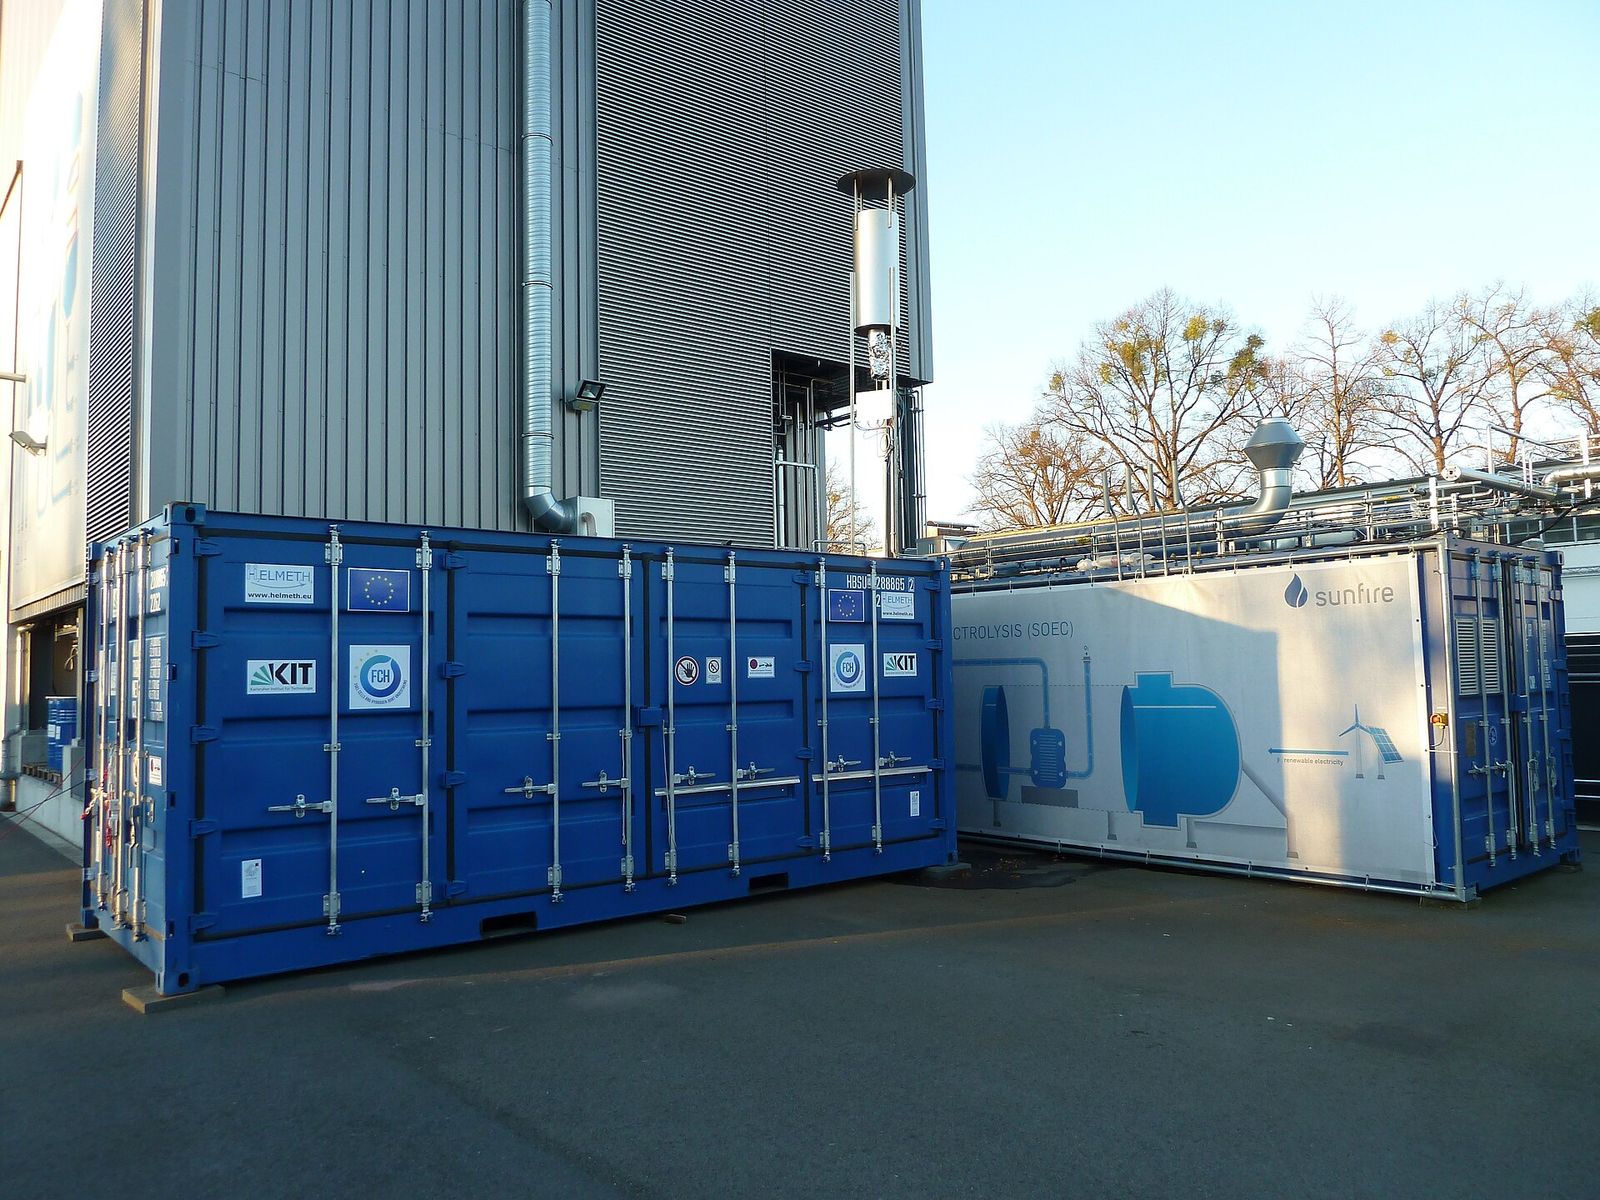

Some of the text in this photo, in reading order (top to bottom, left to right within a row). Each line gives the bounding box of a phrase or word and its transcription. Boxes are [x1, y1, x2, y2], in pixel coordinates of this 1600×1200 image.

[846, 574, 867, 589] HBSU
[876, 577, 905, 591] 288865
[247, 592, 312, 600] www.helmeth.eu
[1315, 583, 1394, 607] sunfire
[953, 621, 1074, 640] CTROLYSIS (SOEC)
[842, 663, 854, 673] FCH
[893, 655, 915, 671] KIT
[268, 663, 313, 685] KIT
[371, 669, 390, 683] FCH
[1315, 758, 1344, 767] electricity
